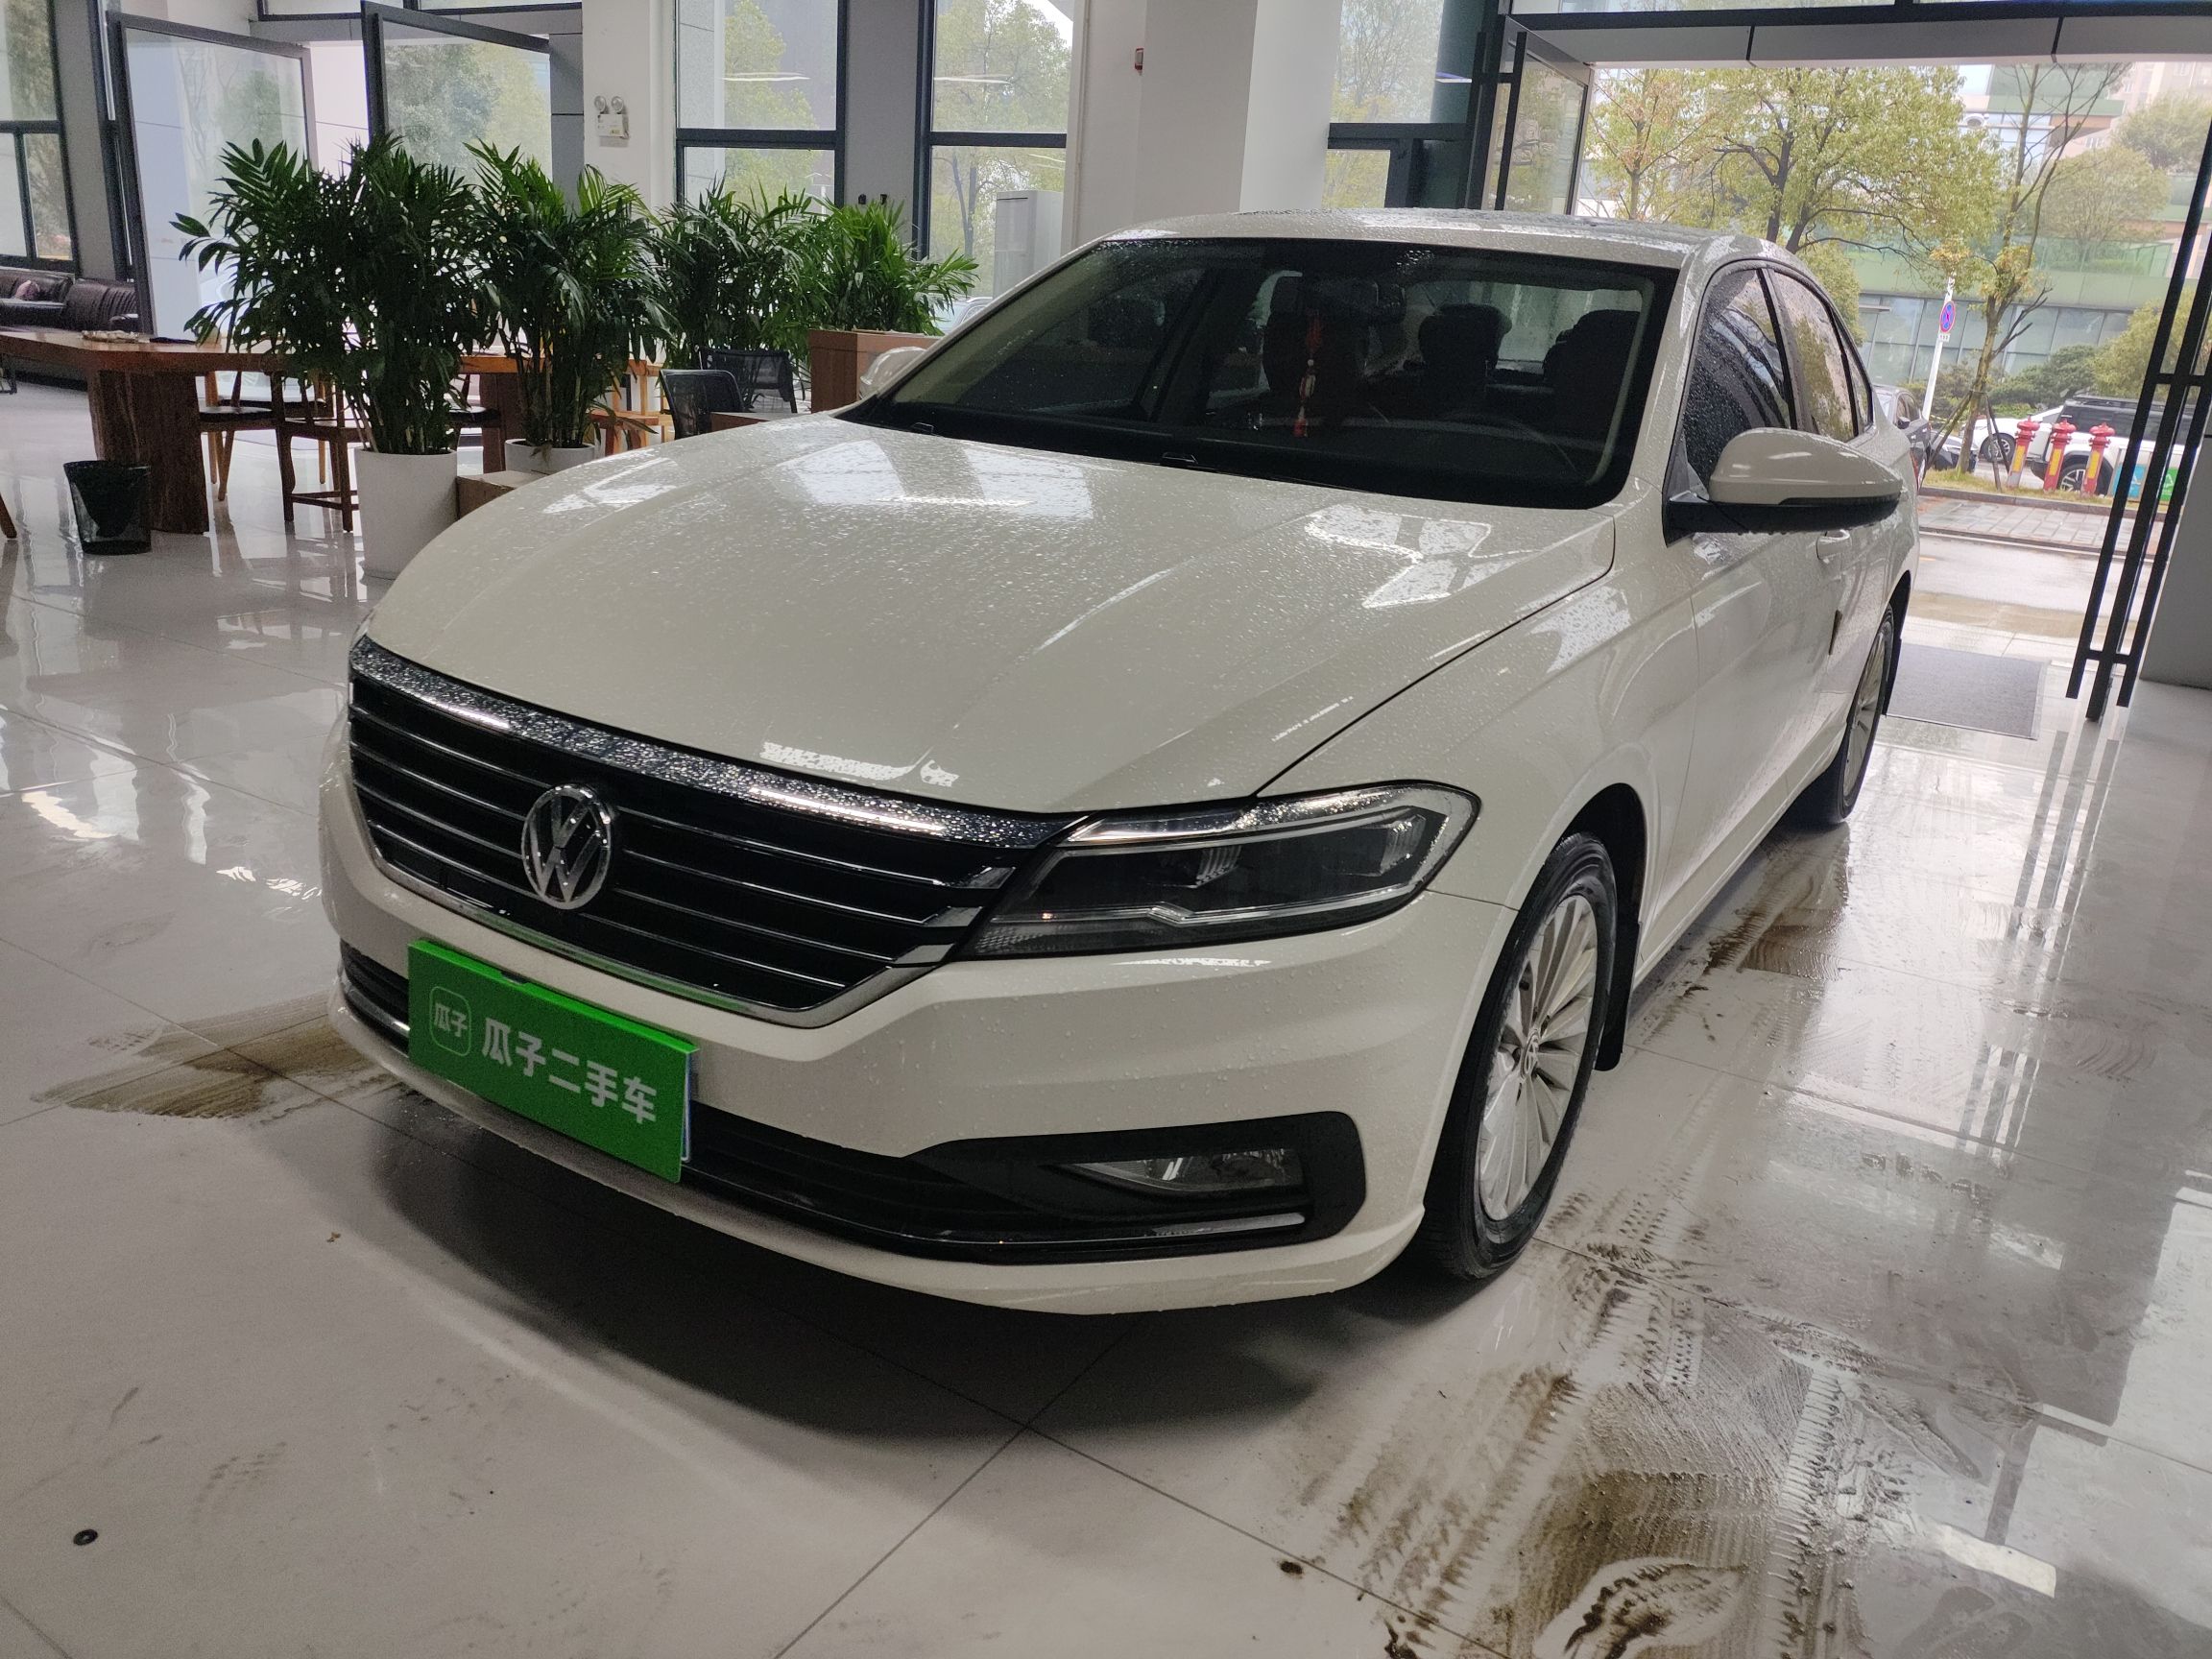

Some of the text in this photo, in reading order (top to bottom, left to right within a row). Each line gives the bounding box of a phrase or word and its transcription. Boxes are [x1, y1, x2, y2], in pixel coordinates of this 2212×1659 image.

[434, 1002, 468, 1038] 瓜子
[481, 1017, 658, 1125] 瓜子二手车
